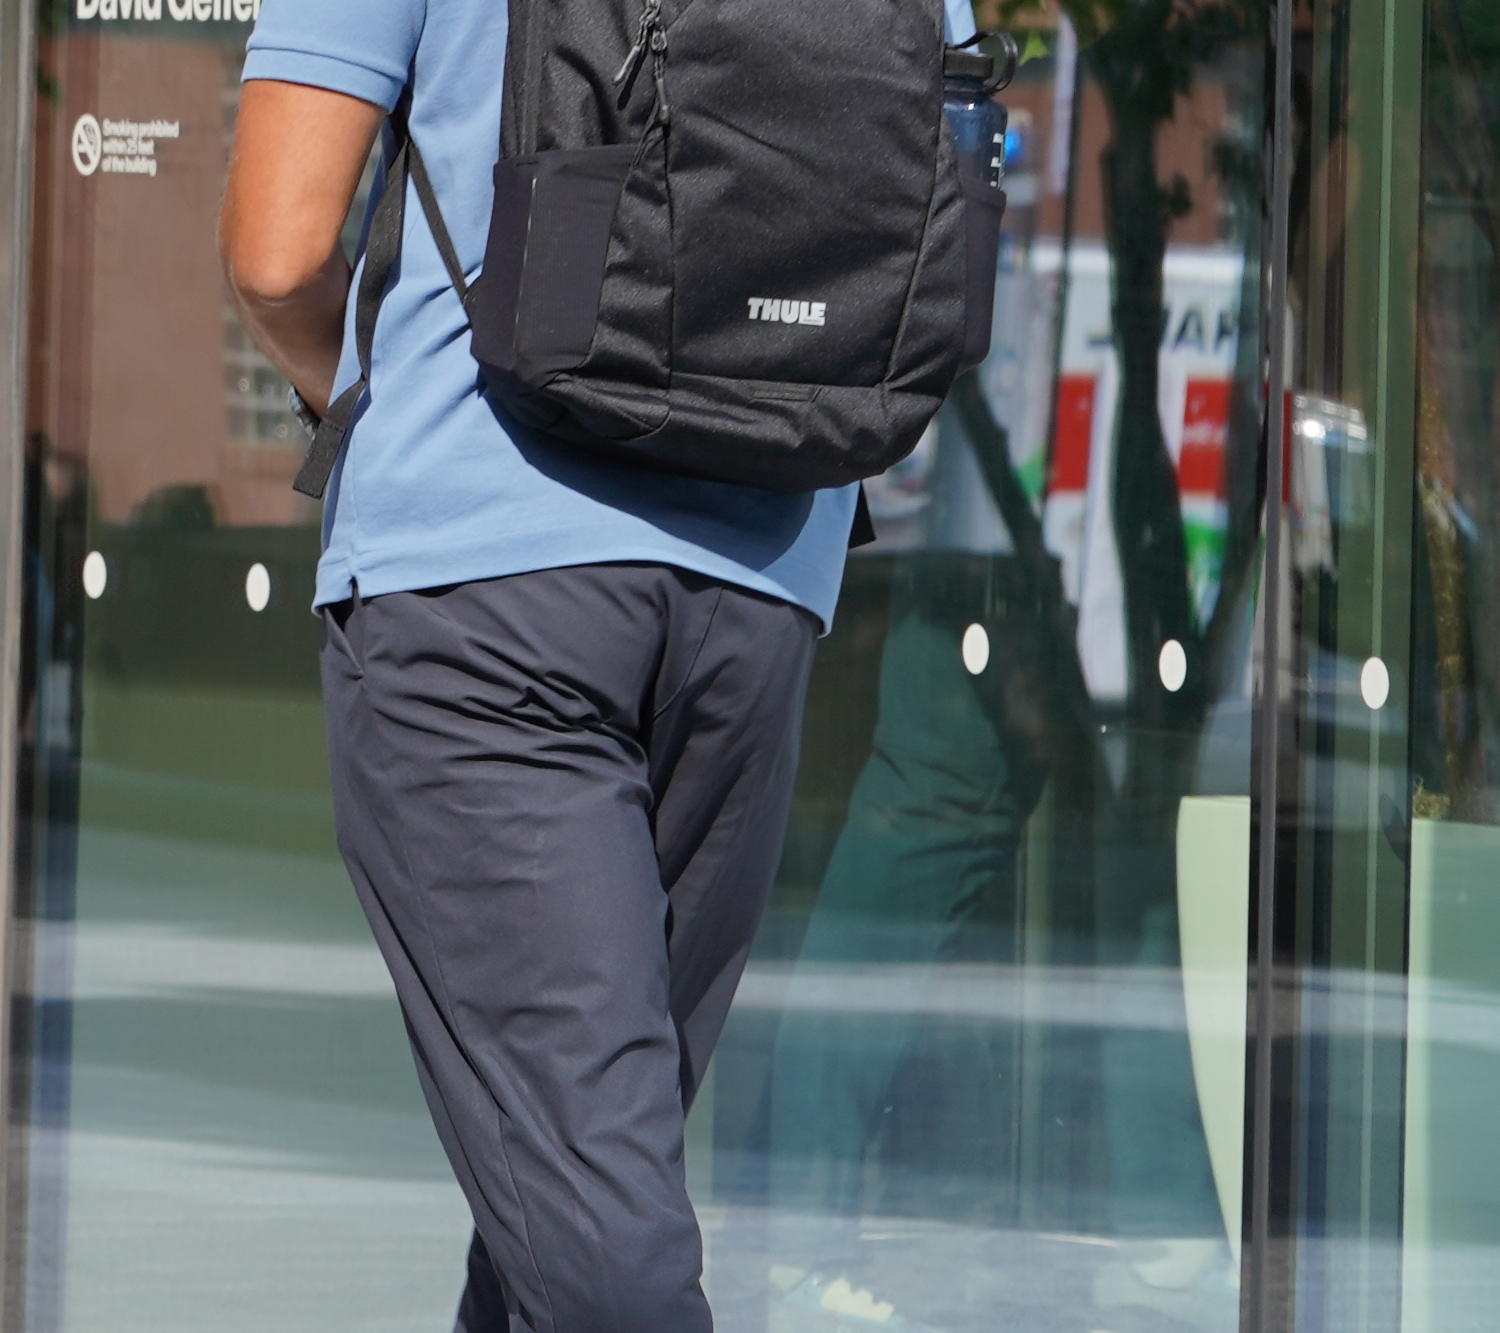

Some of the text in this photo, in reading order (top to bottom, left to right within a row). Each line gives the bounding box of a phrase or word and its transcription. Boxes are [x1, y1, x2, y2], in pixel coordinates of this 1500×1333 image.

[102, 117, 138, 139] Smoking
[125, 155, 157, 176] building
[747, 297, 826, 326] THULE
